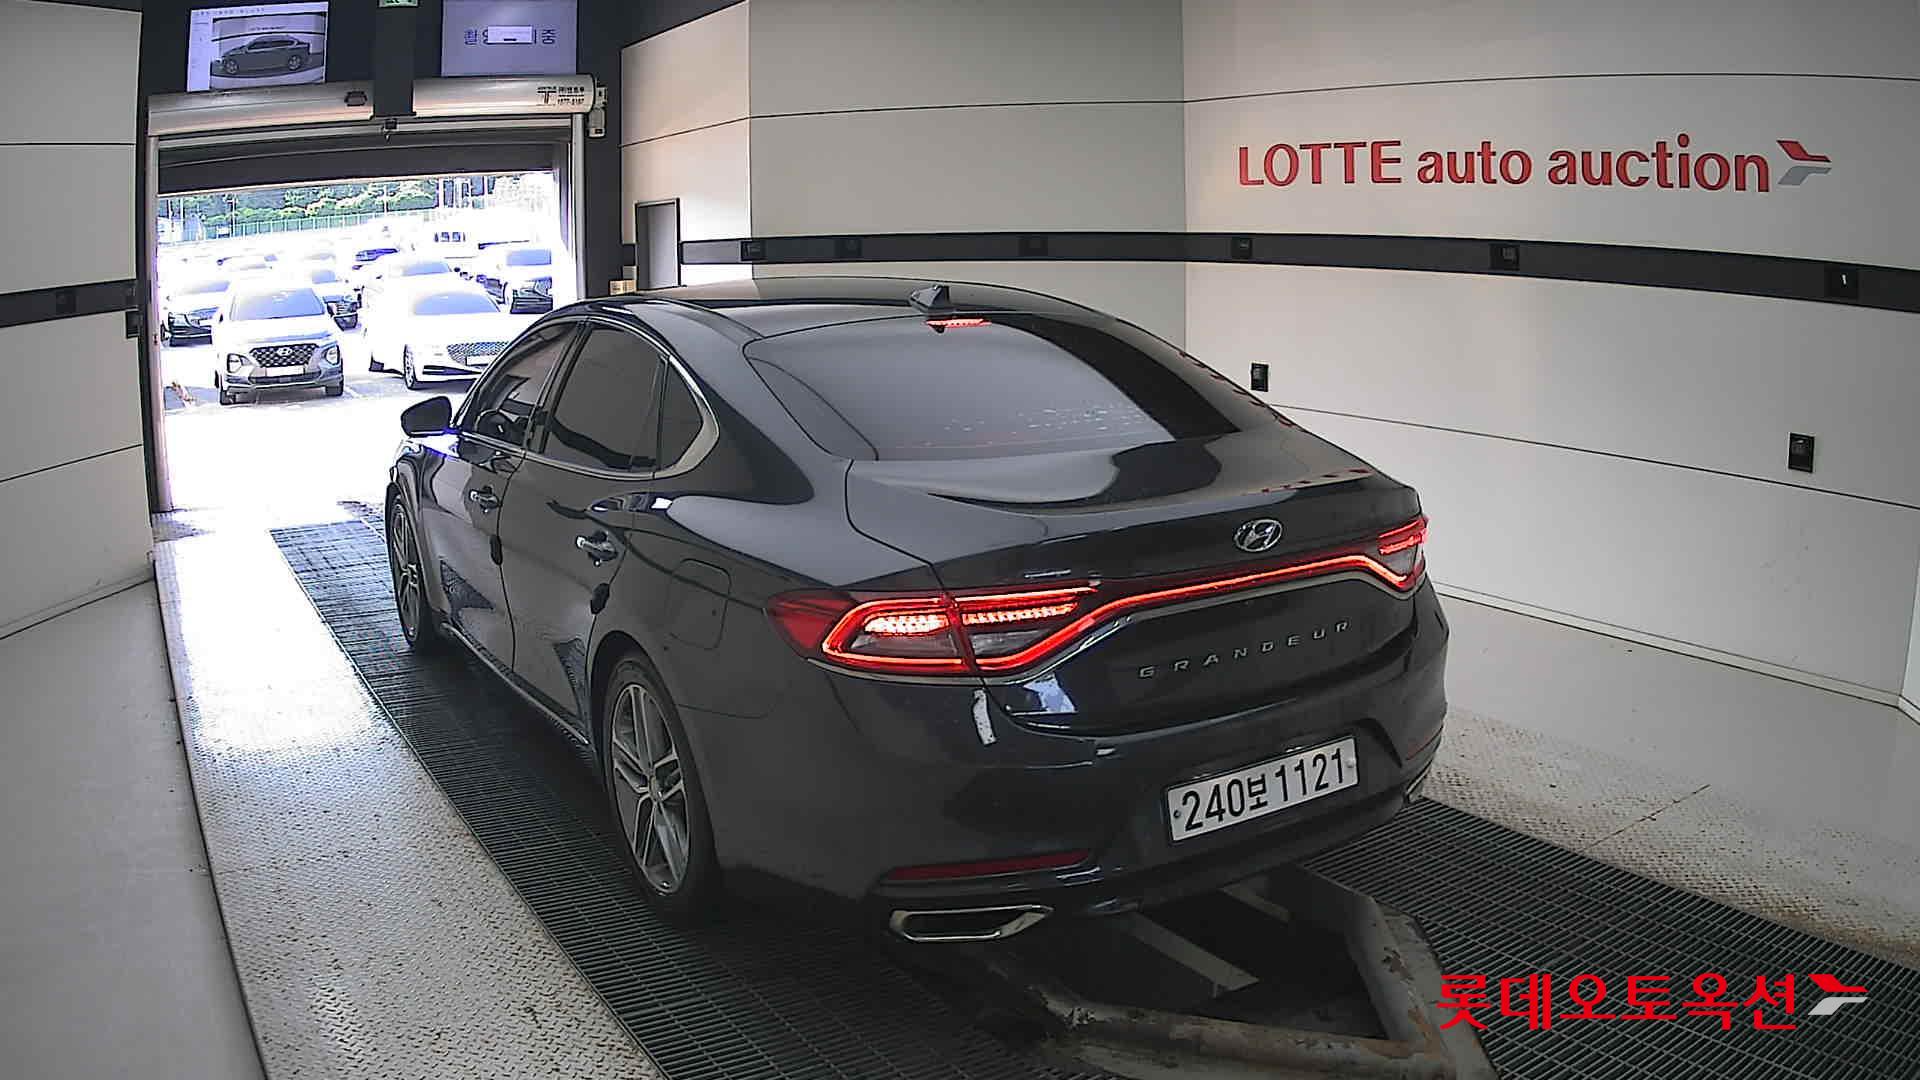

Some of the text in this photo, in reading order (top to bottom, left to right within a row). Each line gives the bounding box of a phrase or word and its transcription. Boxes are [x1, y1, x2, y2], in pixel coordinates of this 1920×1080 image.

[1238, 132, 1770, 193] LOTTE auto auction
[1138, 620, 1351, 679] GRANDEUR
[1181, 747, 1346, 832] 240보1121
